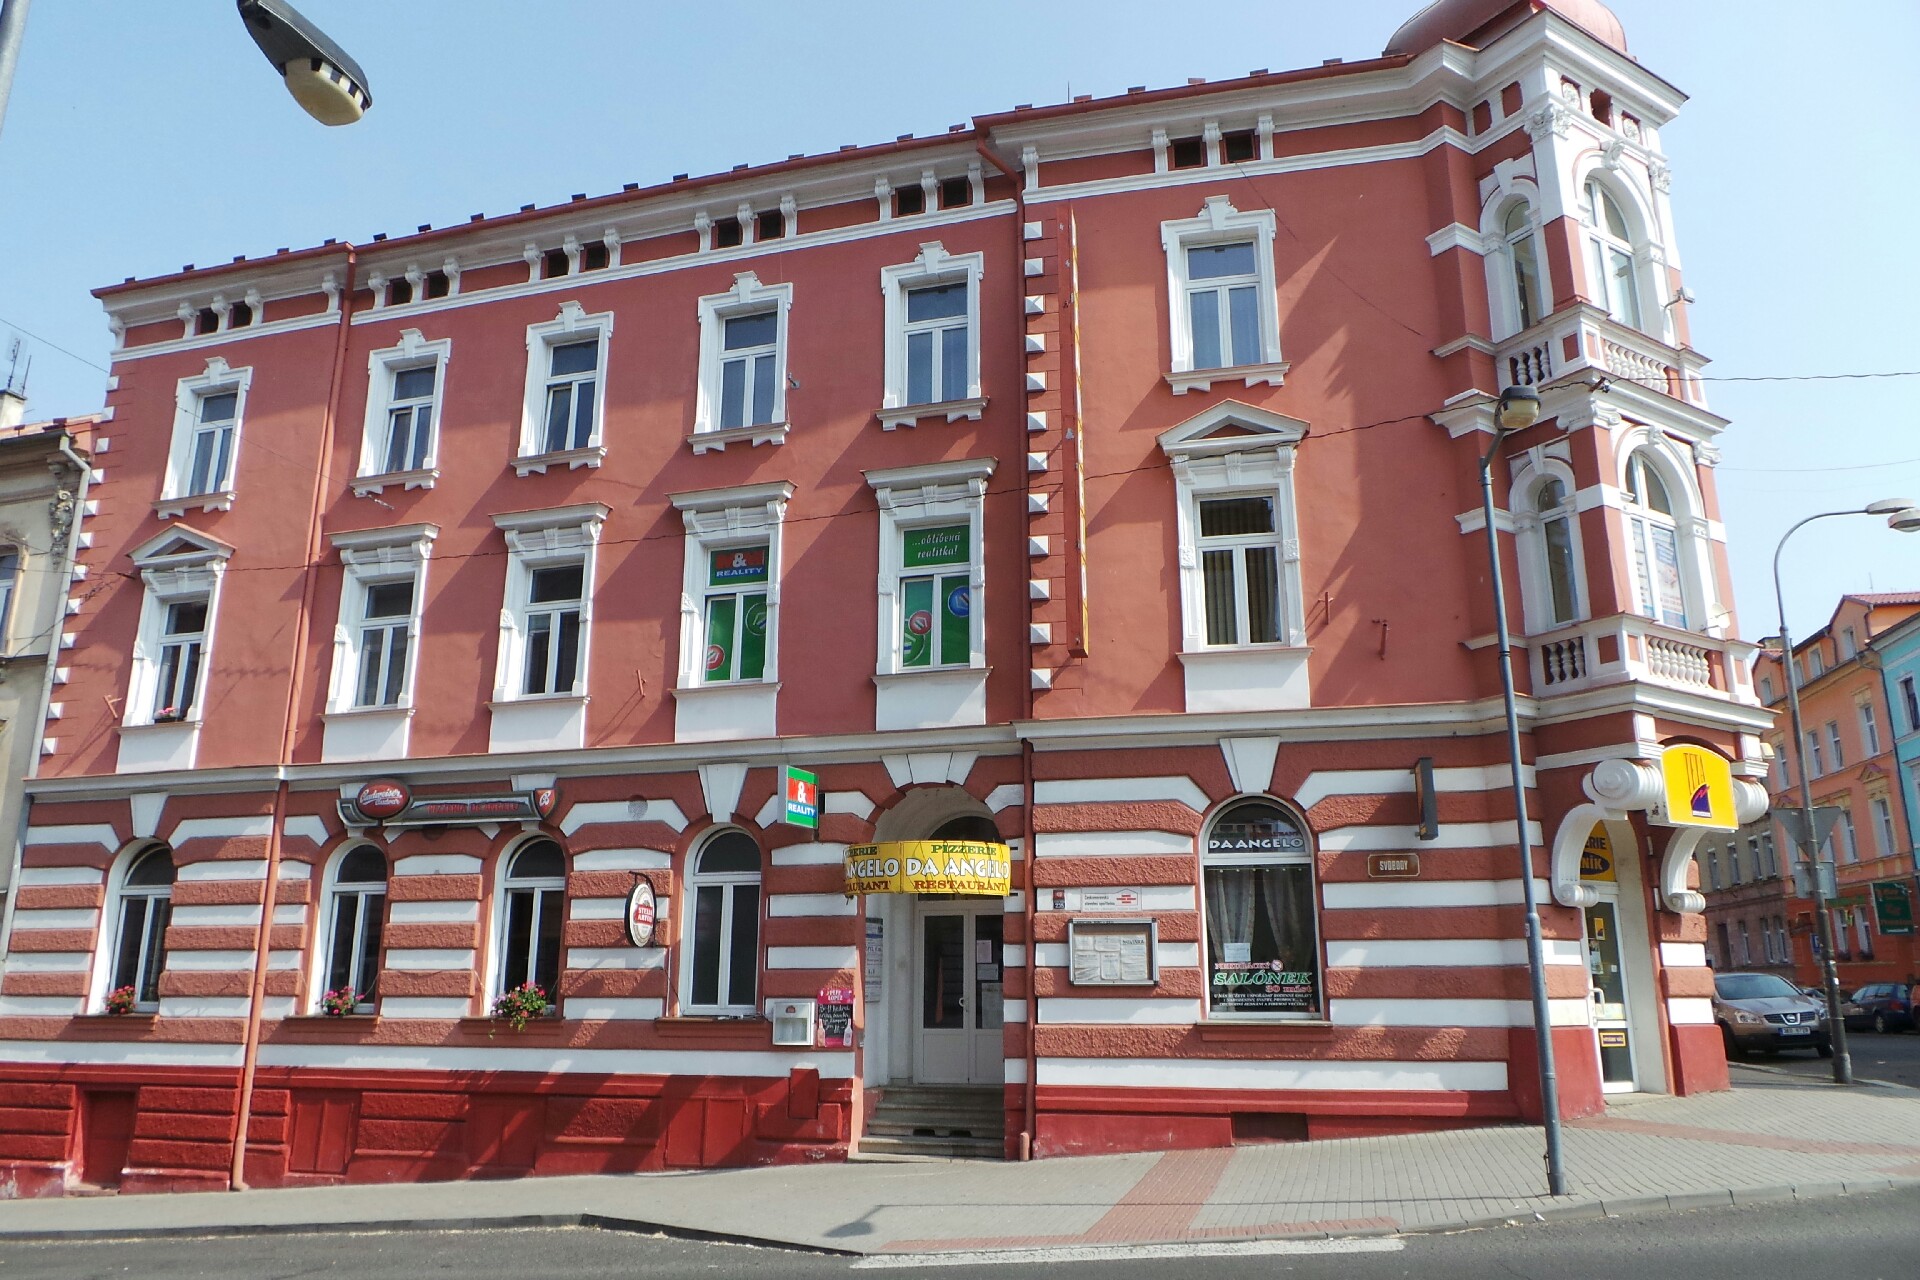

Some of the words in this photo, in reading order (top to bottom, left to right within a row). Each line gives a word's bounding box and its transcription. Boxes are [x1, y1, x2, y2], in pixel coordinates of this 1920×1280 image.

[716, 567, 763, 577] REALITY
[788, 802, 816, 817] REALITY
[1210, 840, 1233, 848] DA
[1235, 838, 1304, 848] ANGELO
[931, 844, 997, 856] PIZZERIE
[906, 858, 939, 877] DA
[943, 858, 1010, 879] ANGELO
[1380, 860, 1408, 871] SVOBODY
[913, 880, 1006, 892] RESTAURANT
[1213, 969, 1313, 985] SALÓNEK
